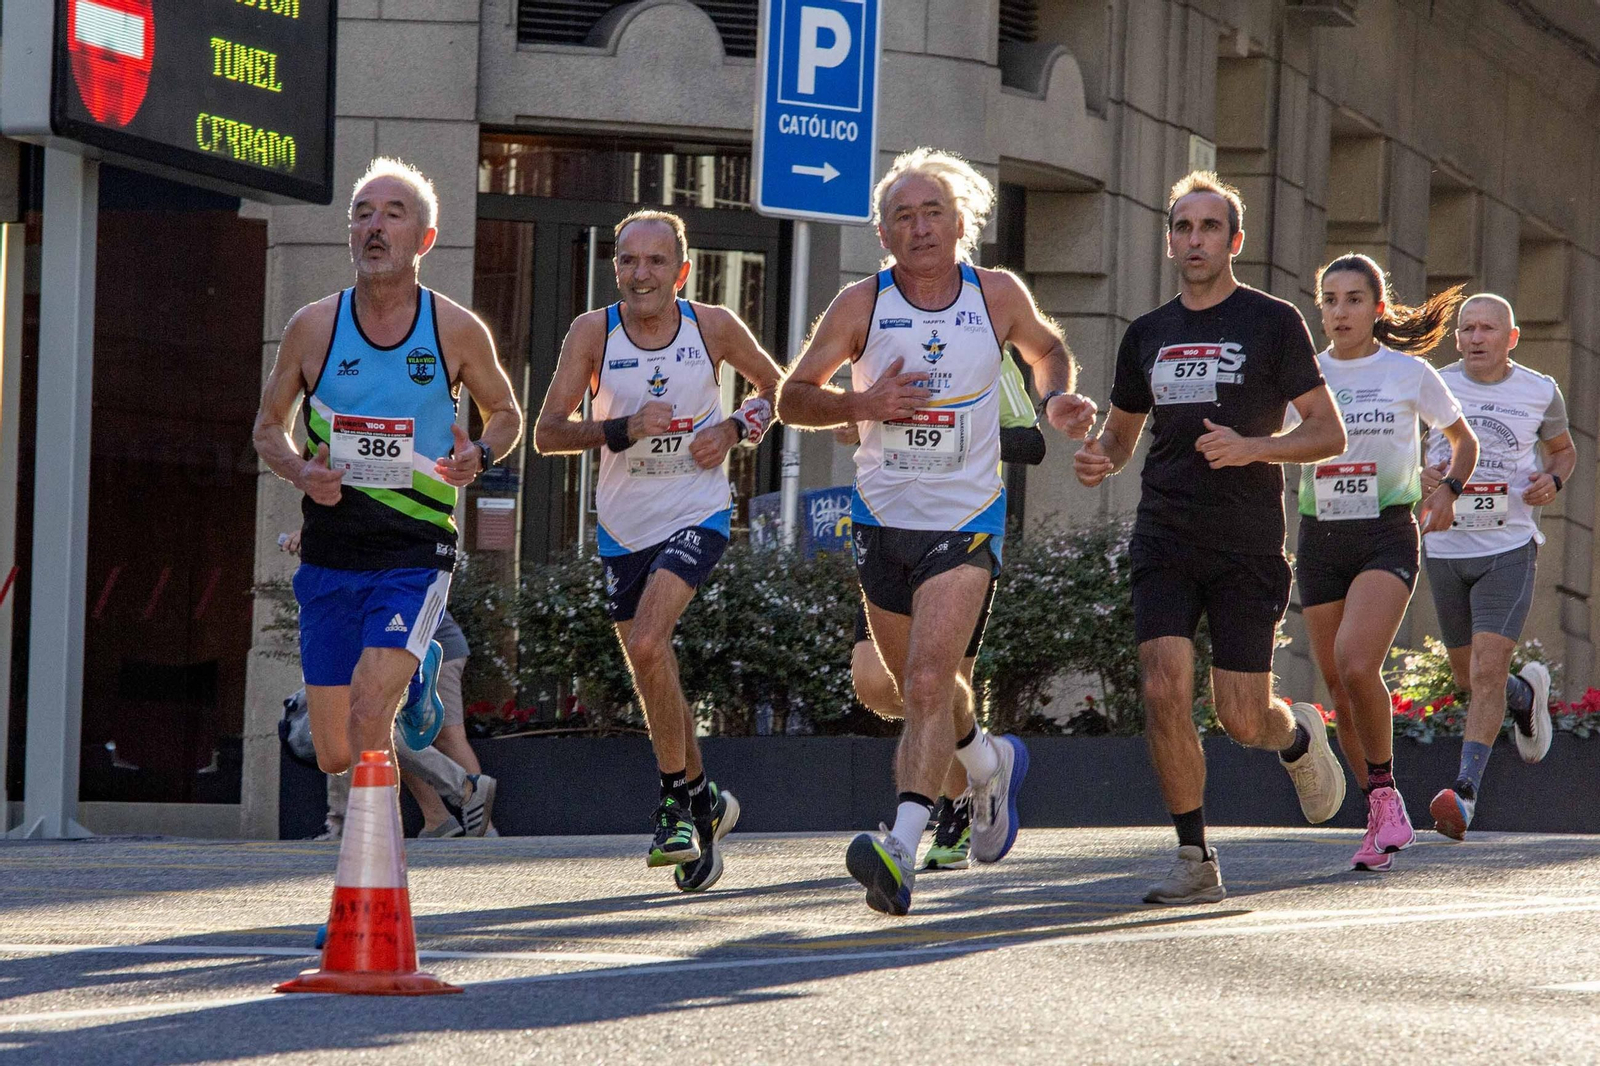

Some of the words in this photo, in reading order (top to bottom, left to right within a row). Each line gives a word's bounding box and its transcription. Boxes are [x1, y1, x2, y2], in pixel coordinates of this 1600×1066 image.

[797, 6, 852, 95] P
[211, 37, 282, 92] TUNEL
[779, 114, 858, 142] CATÓLICO
[1174, 362, 1208, 378] 573
[1341, 408, 1395, 424] archa
[366, 422, 385, 430] VIGO
[1482, 419, 1516, 448] ROSQUILLA
[651, 437, 682, 453] 217
[905, 428, 942, 447] 159
[357, 437, 401, 458] 386
[1477, 460, 1504, 468] ETEA
[1334, 479, 1368, 494] 455
[1474, 497, 1494, 510] 23
